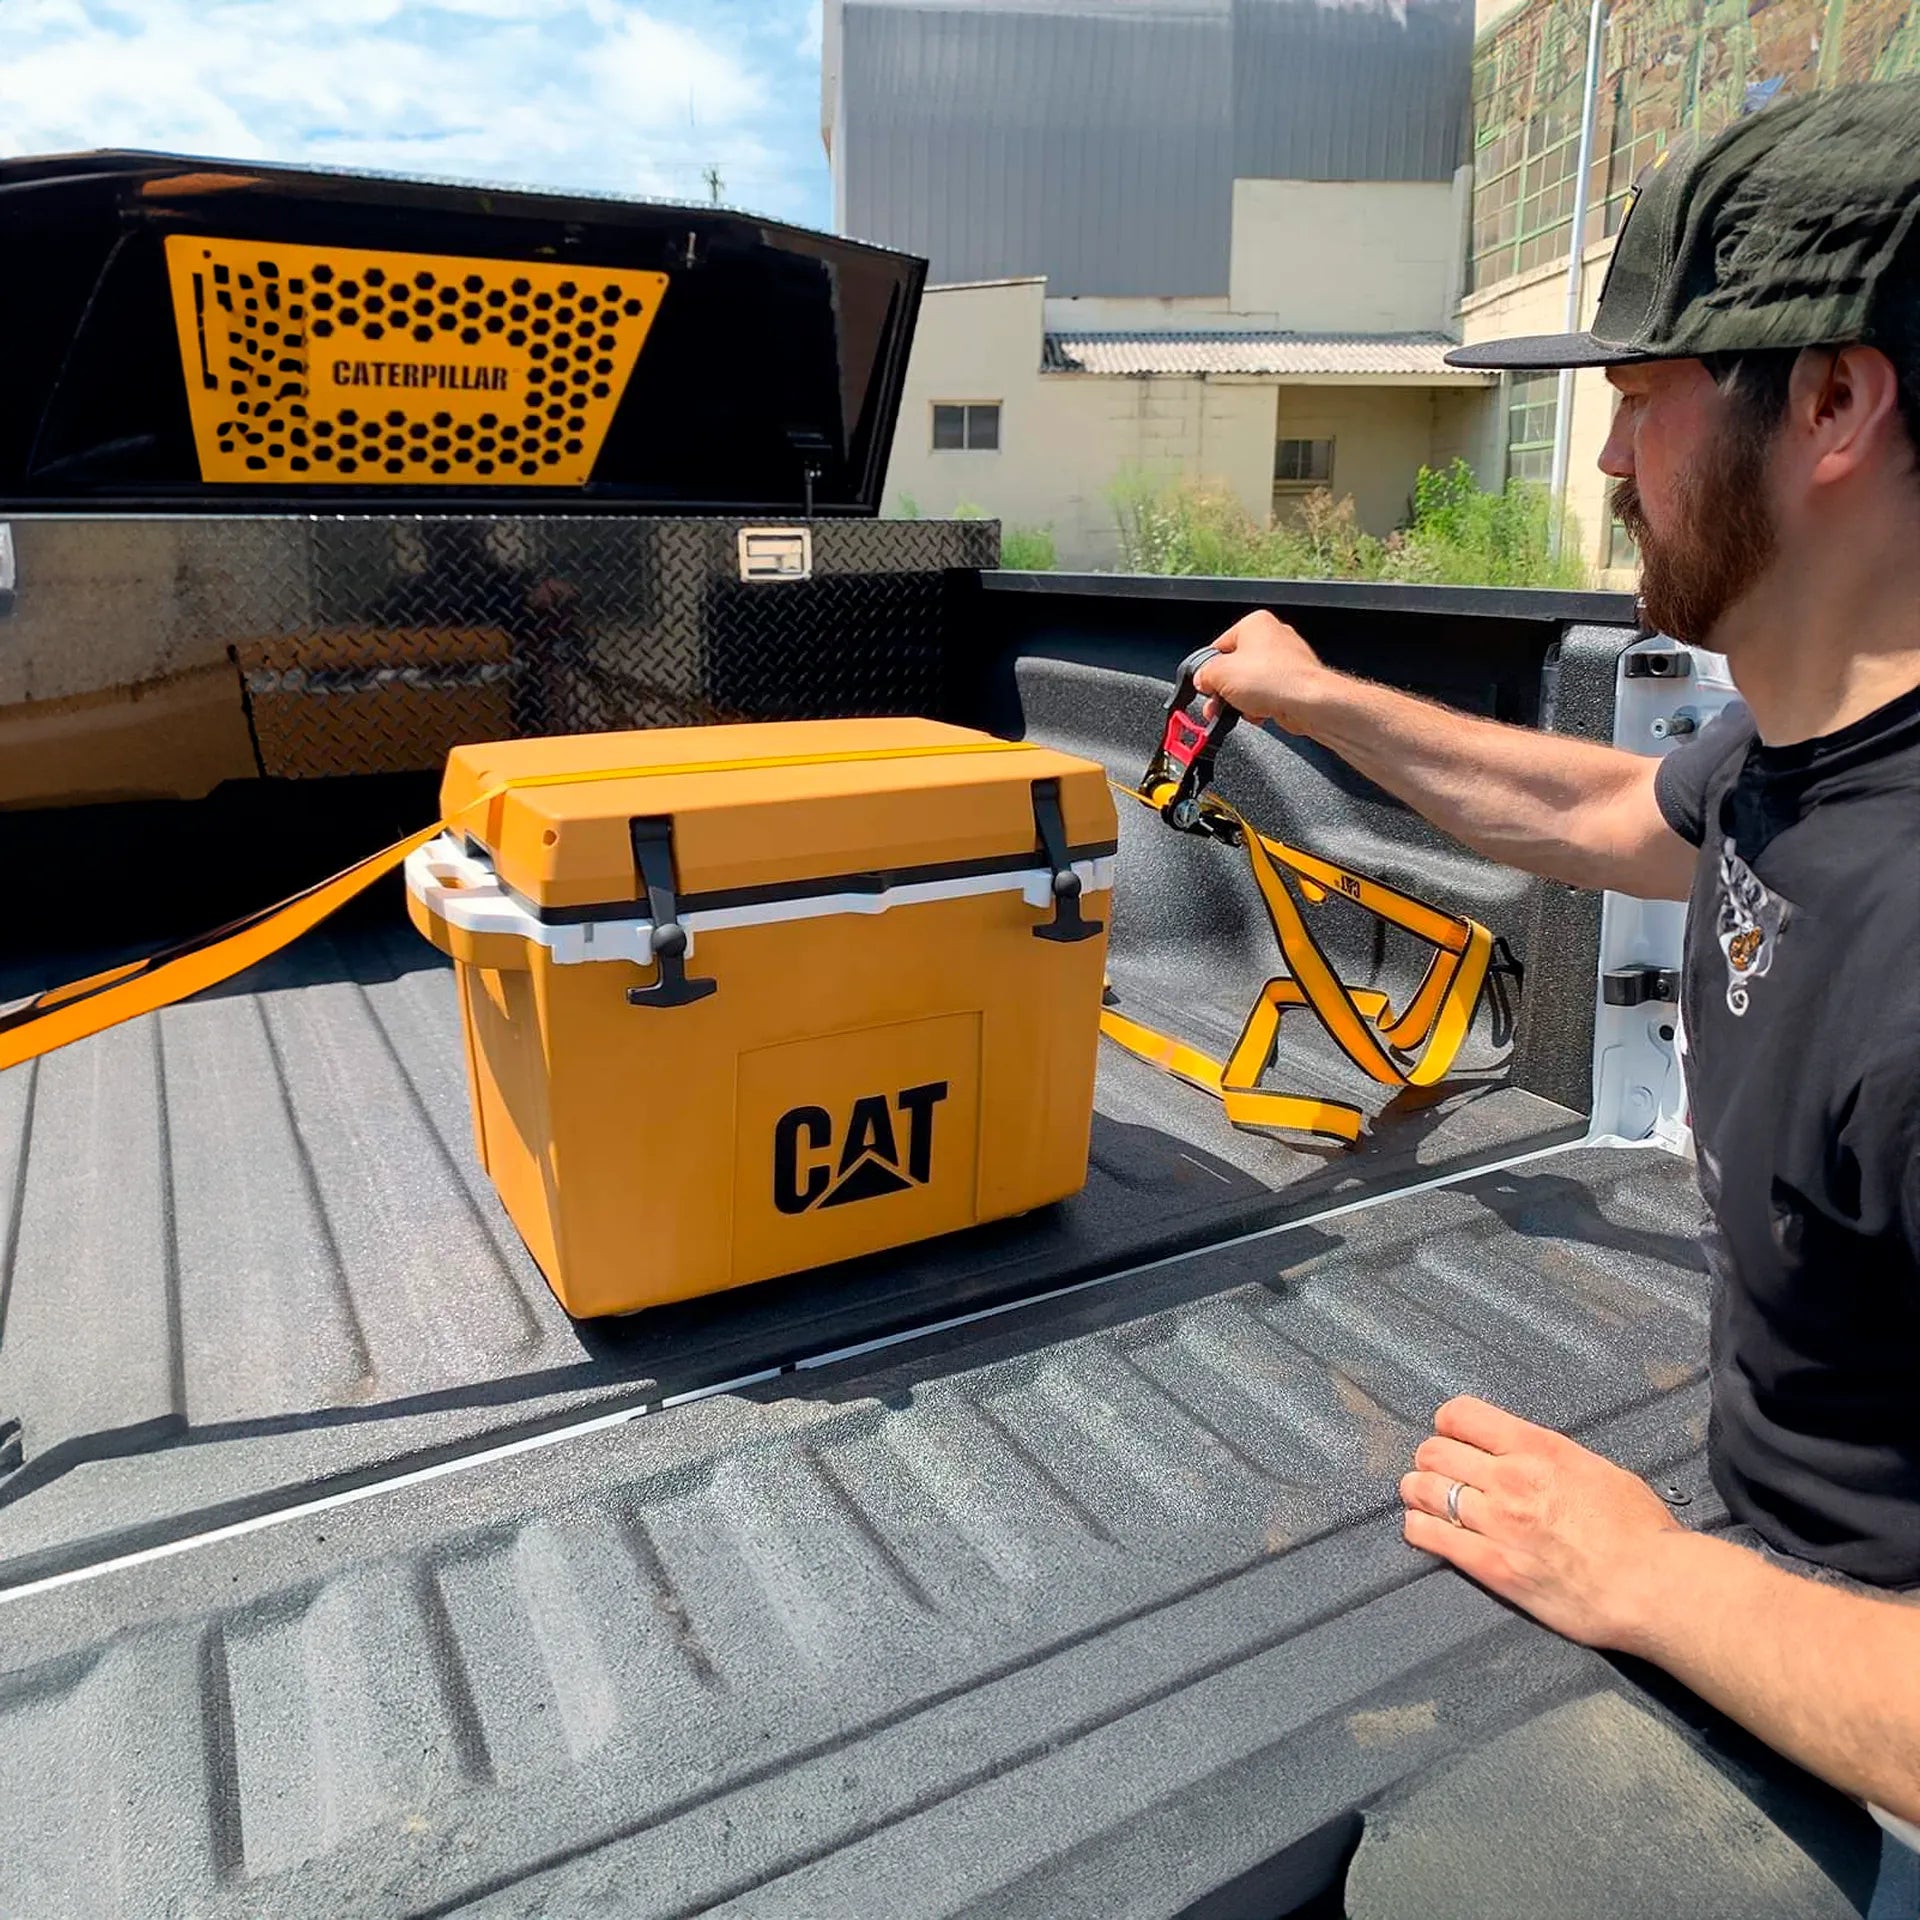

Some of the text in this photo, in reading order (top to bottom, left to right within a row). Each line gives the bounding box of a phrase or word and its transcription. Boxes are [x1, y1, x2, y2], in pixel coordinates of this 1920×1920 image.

[333, 361, 507, 391] CATERPILLAR
[1341, 875, 1360, 899] CAT
[774, 1081, 948, 1214] CAT
